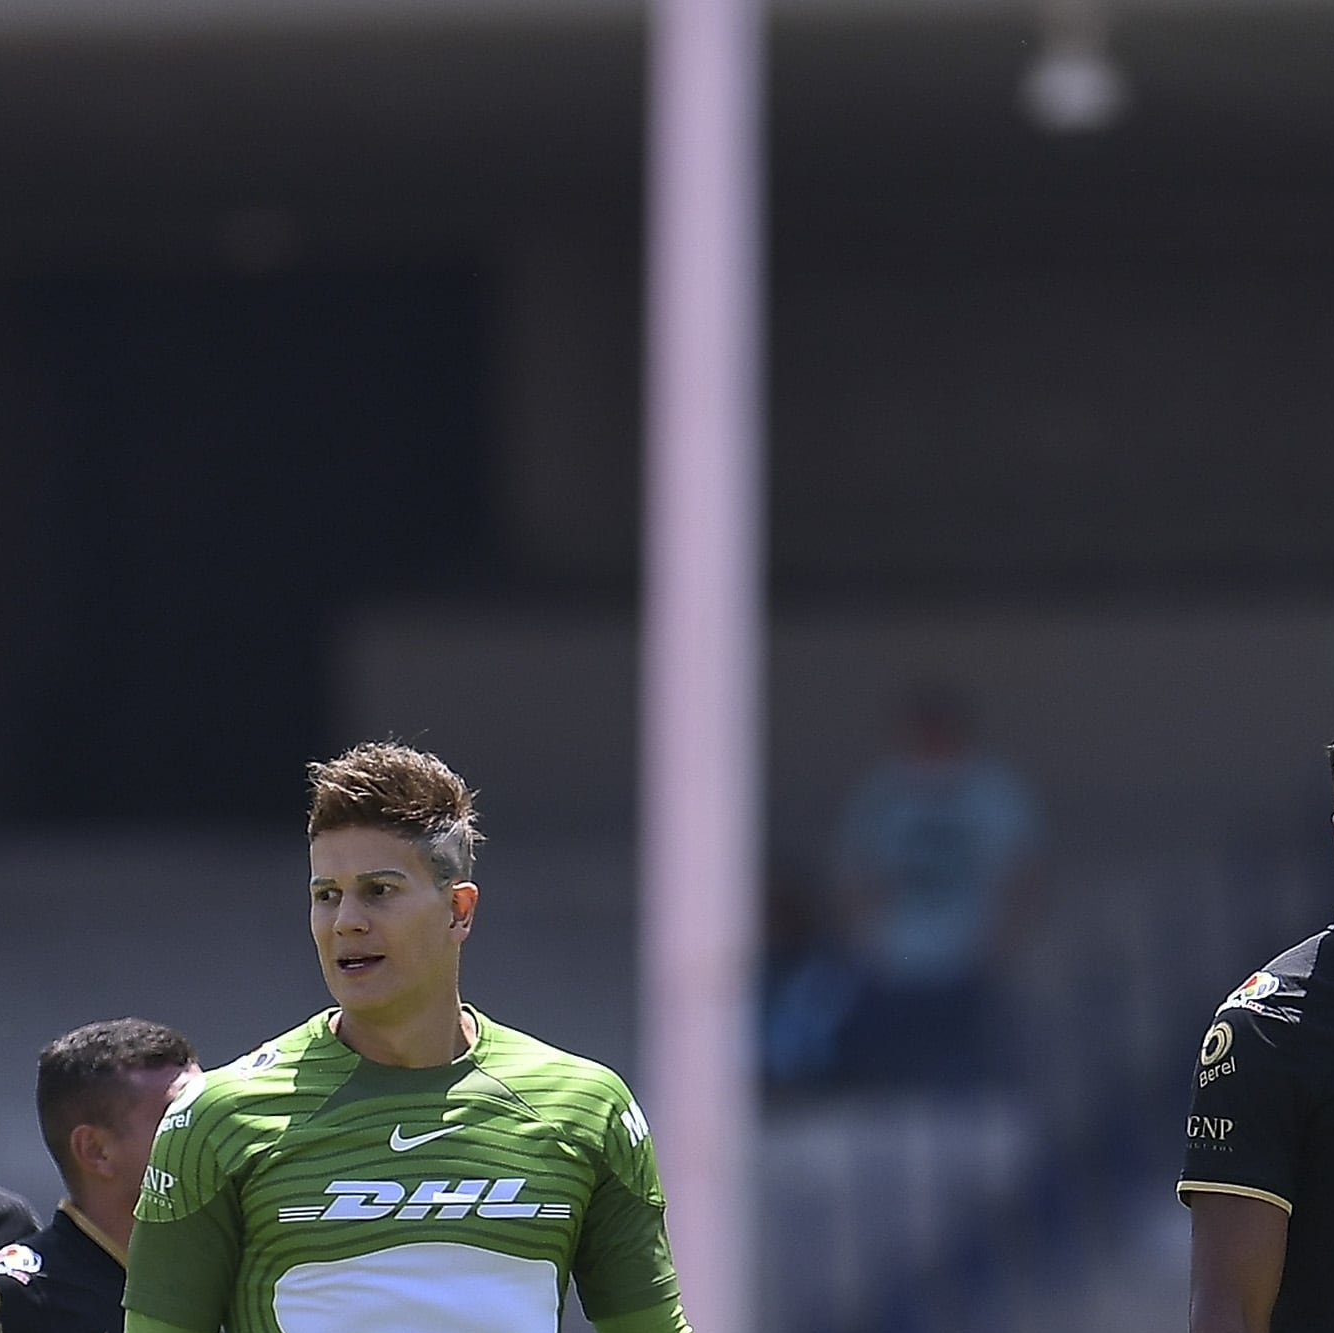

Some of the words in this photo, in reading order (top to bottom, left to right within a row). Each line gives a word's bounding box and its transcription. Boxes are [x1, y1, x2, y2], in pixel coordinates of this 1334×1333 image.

[1199, 1057, 1236, 1088] Berel
[156, 1110, 192, 1137] erel
[1186, 1115, 1235, 1141] GNP
[142, 1165, 175, 1195] NP
[320, 1178, 542, 1221] DHL
